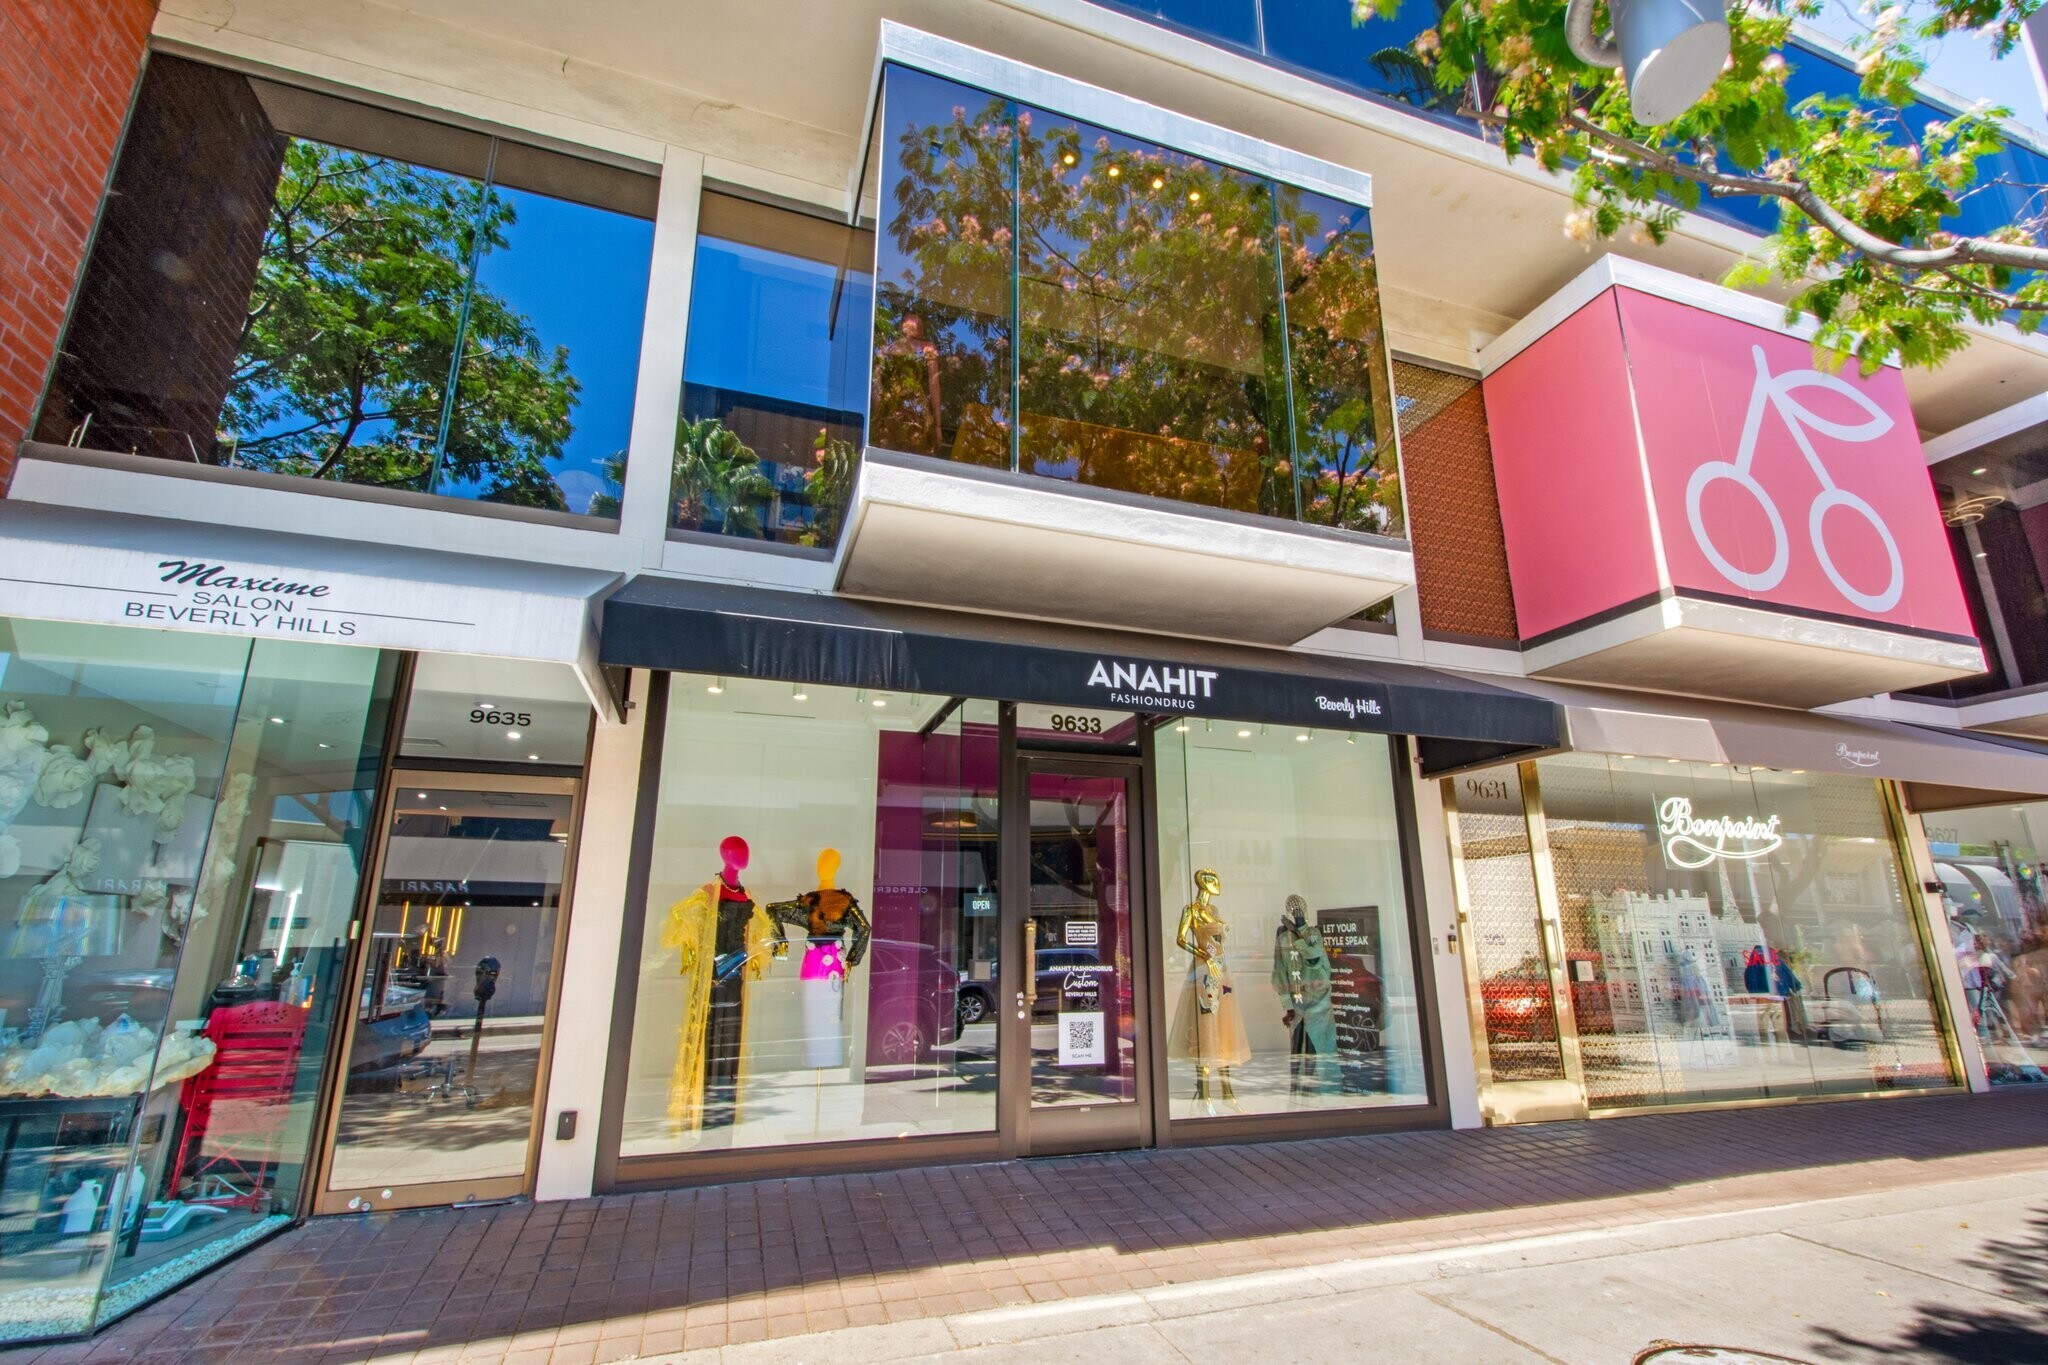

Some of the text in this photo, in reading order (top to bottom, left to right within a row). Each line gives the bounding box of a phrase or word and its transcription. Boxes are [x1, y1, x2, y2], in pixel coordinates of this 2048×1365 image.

[158, 560, 330, 598] Maxime
[192, 591, 293, 612] SALON
[124, 602, 356, 636] BEVERLY HILLS
[1087, 660, 1219, 698] ANAHIT
[1110, 692, 1196, 709] FASHIONDRUG
[1315, 696, 1382, 719] Beverly Hills
[470, 708, 532, 728] 9635
[1051, 713, 1102, 734] 9633
[1466, 777, 1509, 801] 9631
[1659, 796, 1783, 868] Bonpoint
[1926, 826, 1959, 844] 9627
[972, 900, 990, 910] OPEN
[1322, 922, 1357, 934] LET YOUR
[1323, 935, 1369, 946] STYLE SPEAK
[1743, 949, 1781, 967] SALE
[1063, 971, 1099, 990] Custom
